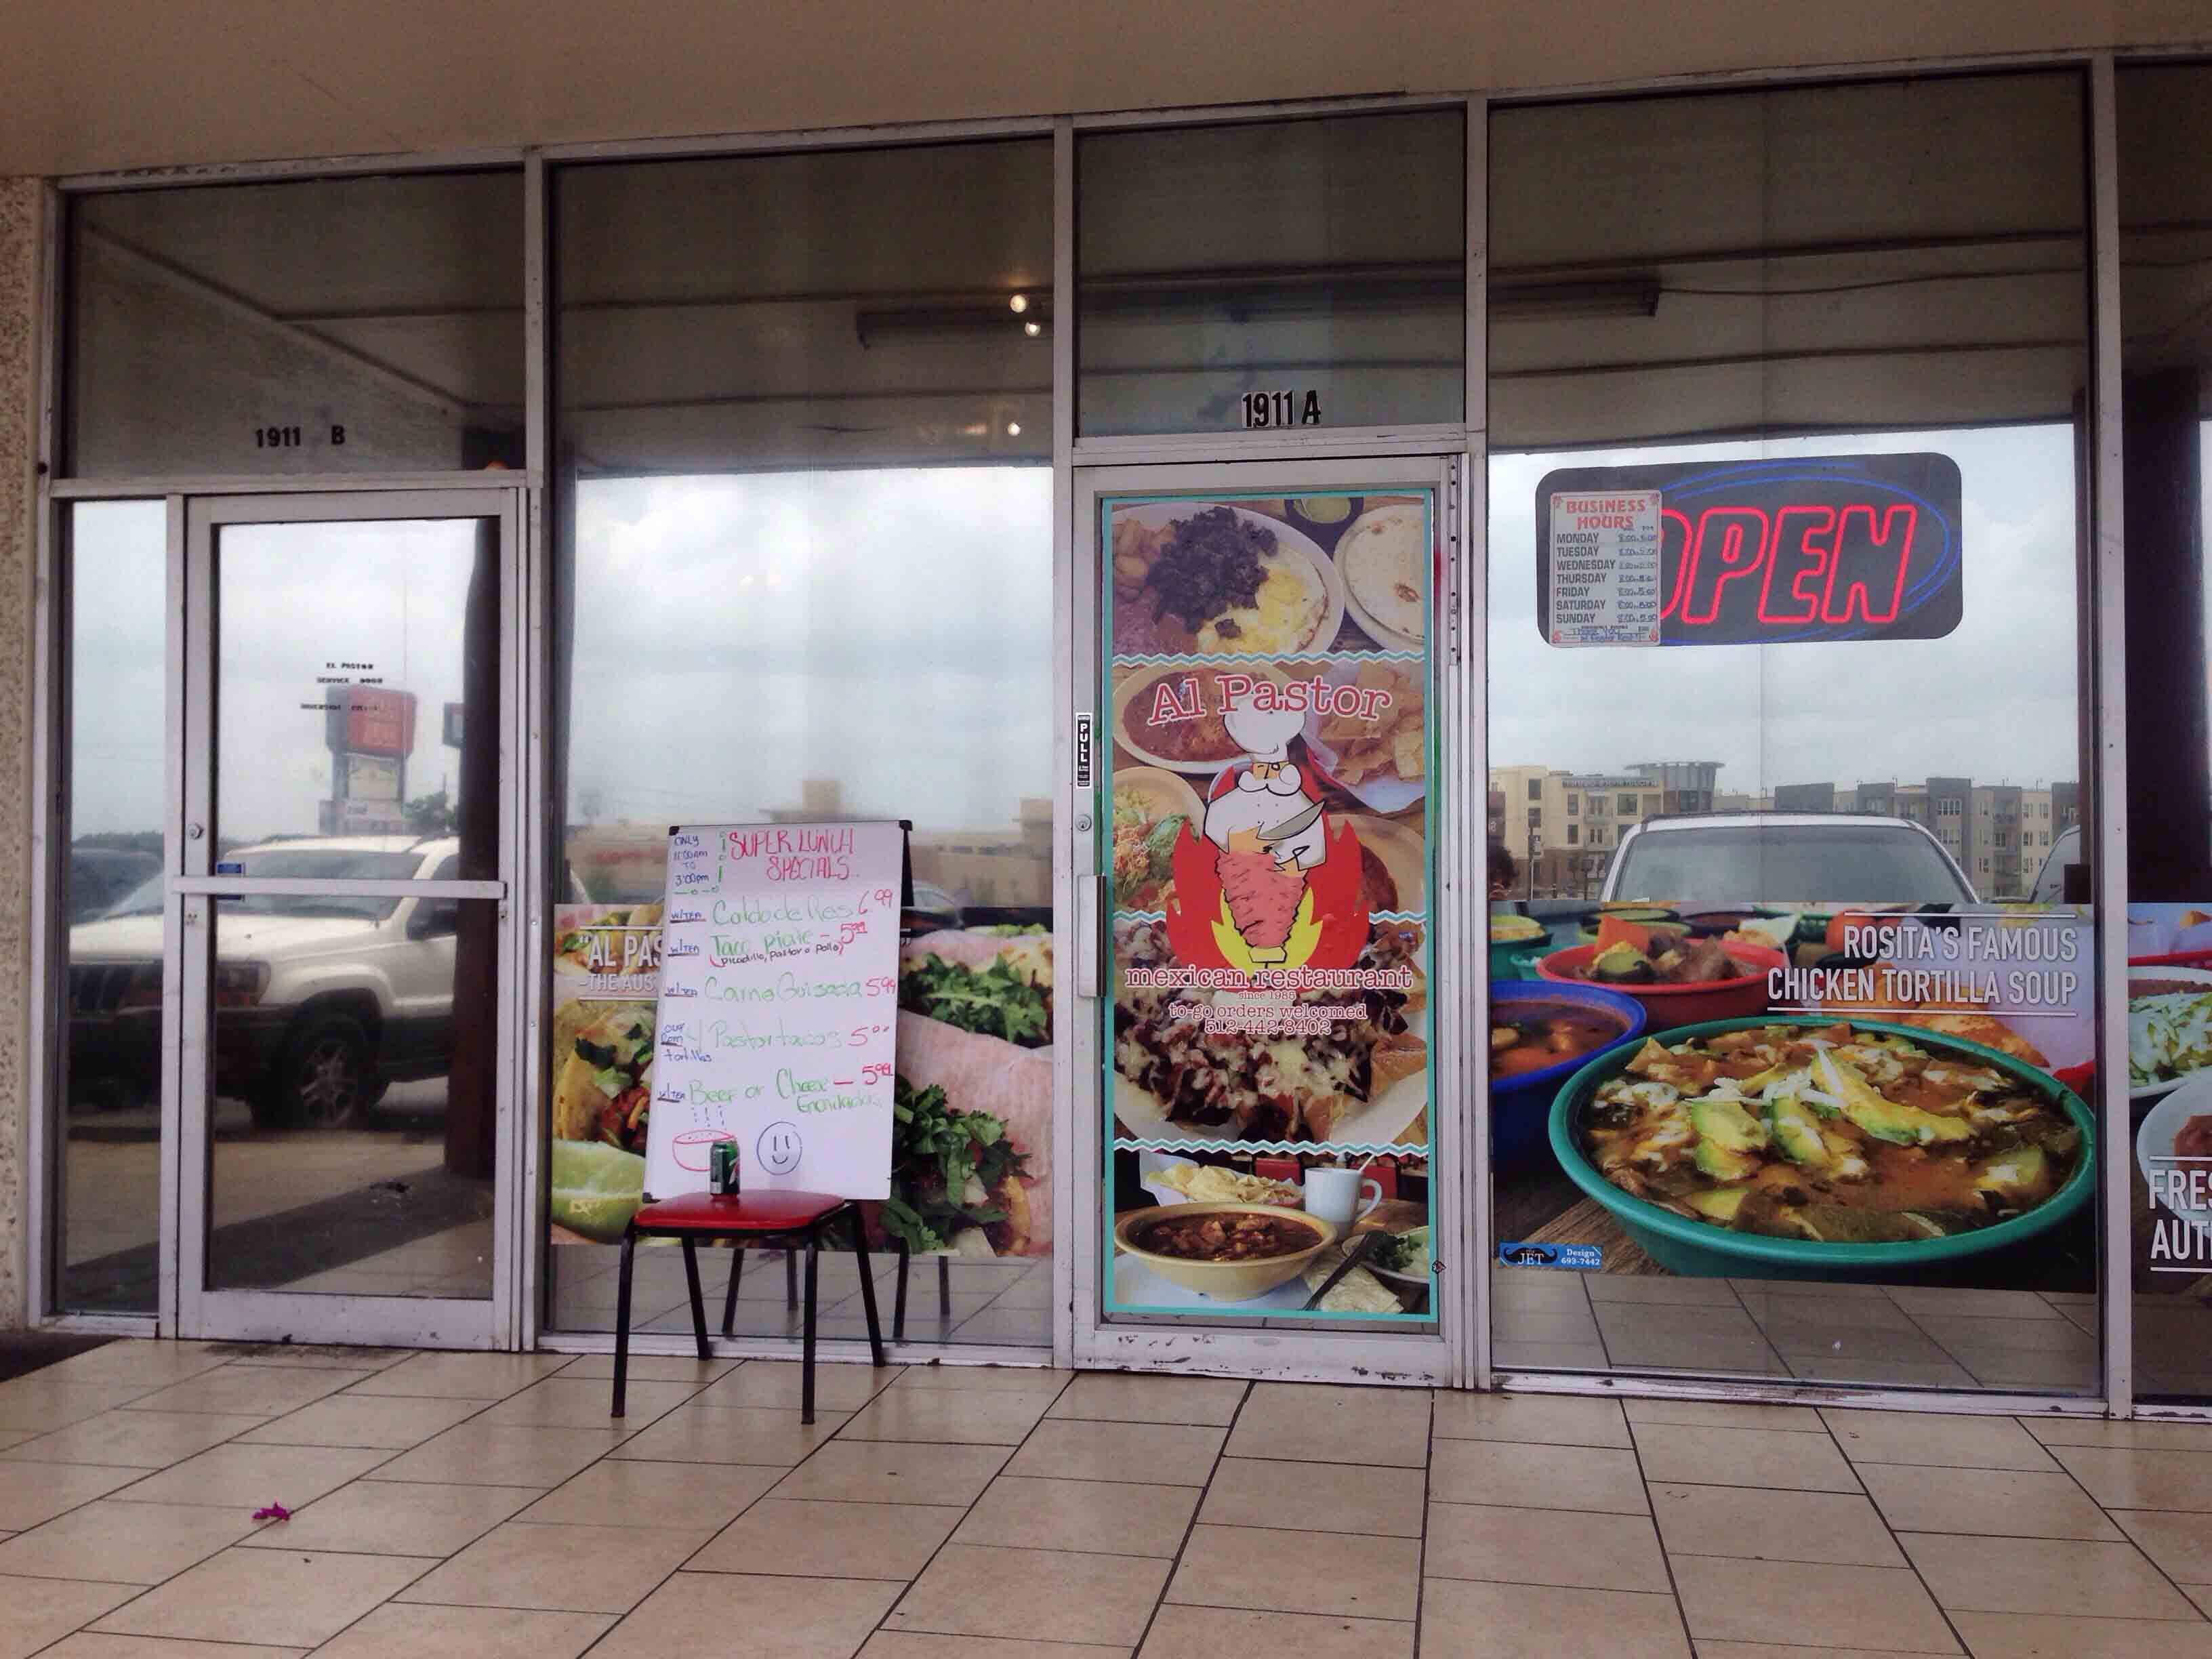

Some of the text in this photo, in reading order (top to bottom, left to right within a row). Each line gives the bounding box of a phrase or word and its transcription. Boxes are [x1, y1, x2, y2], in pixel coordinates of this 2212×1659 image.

[1243, 390, 1322, 427] 1911 A
[256, 425, 346, 448] 1911 B
[1577, 516, 1635, 531] HOURS
[1556, 533, 1599, 544] MONDAY
[1557, 547, 1599, 557] TUESDAY
[1557, 560, 1616, 571] WEDNESDAY
[1557, 573, 1607, 584] THURSDAY
[1557, 586, 1590, 597] FRIDAY
[1557, 600, 1605, 610] SATURDAY
[1556, 613, 1595, 623] SUNDAY
[1148, 675, 1391, 725] Al Pastor
[1080, 723, 1088, 762] PULL
[729, 827, 853, 860] SUPER LUNCH
[1843, 926, 2076, 961] ROSITA'S FAMOUS
[621, 975, 657, 991] AUS
[1125, 965, 1414, 989] mexican restaurant
[1238, 990, 1265, 1000] since
[1767, 968, 2076, 1005] CHICKEN TORTILLA SOUP
[1169, 1003, 1368, 1020] to-go orders welcomed
[1204, 1019, 1332, 1036] 512-442-8402
[2150, 1219, 2212, 1261] AUT
[1518, 1248, 1595, 1265] JET Design
